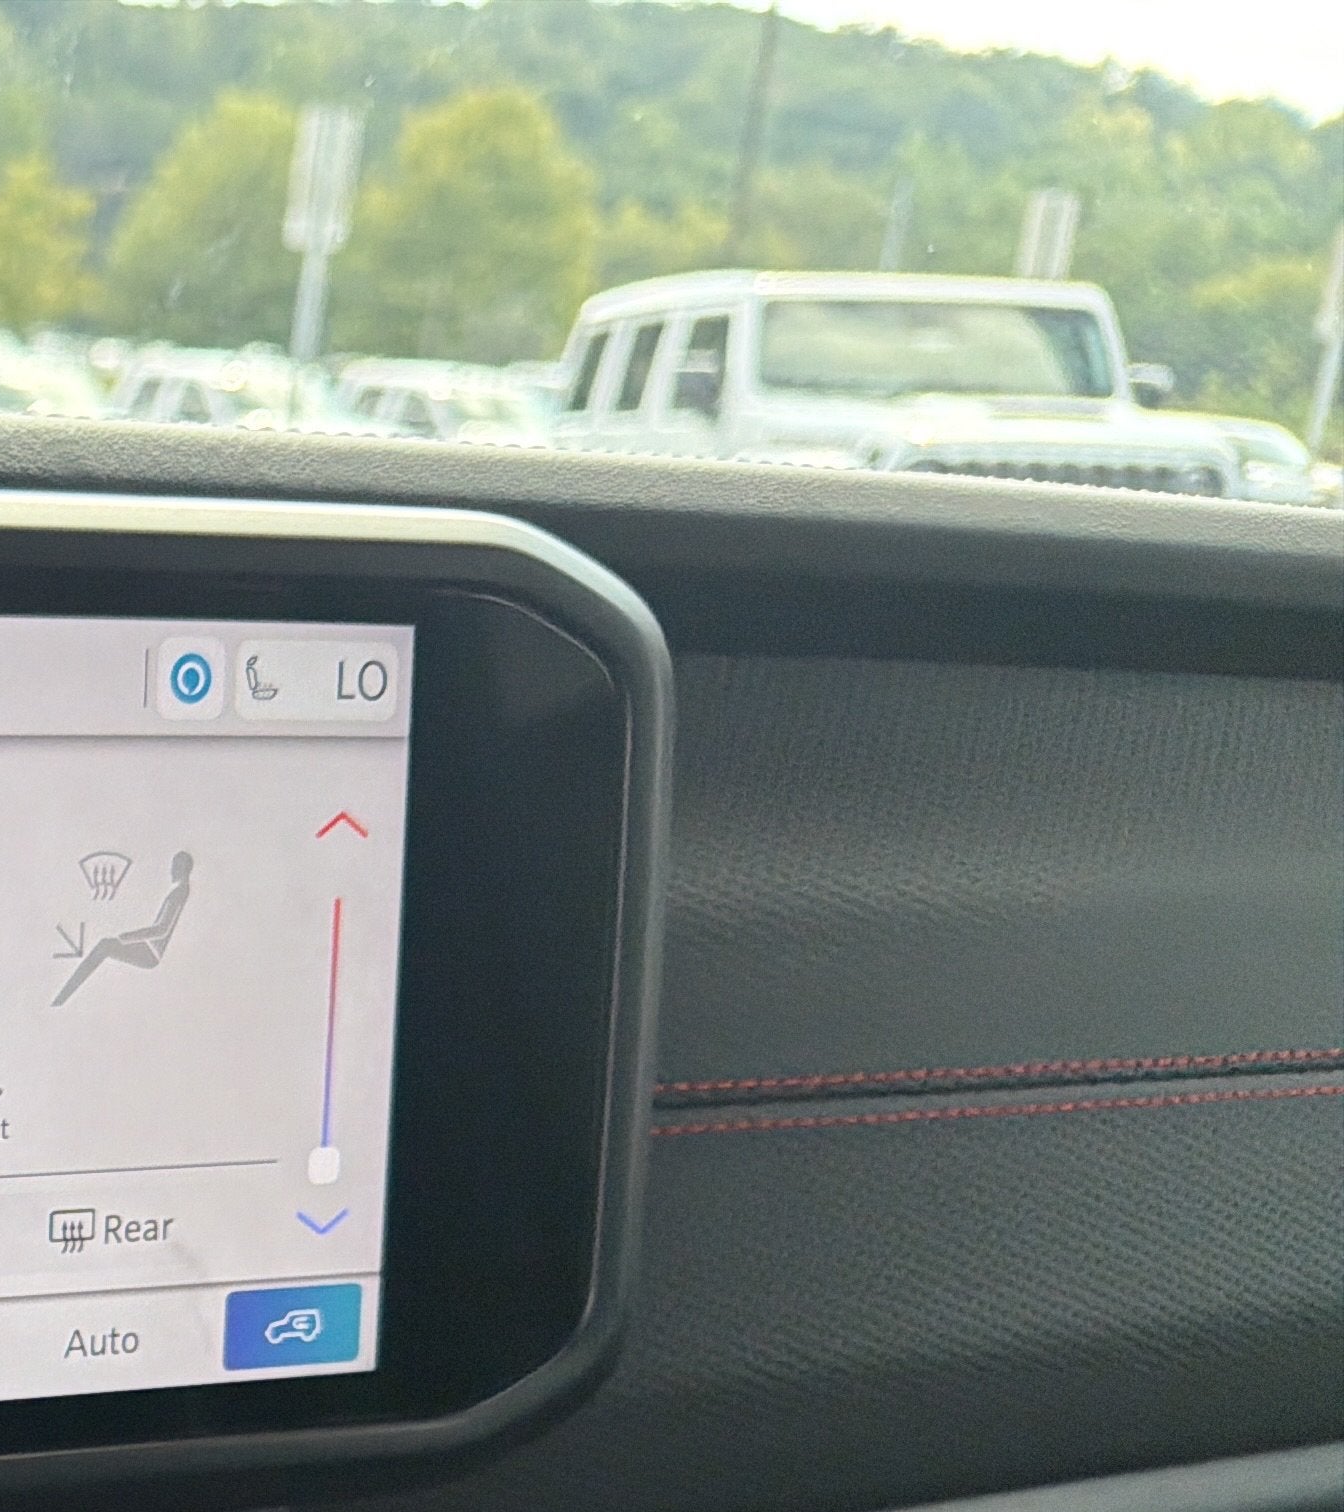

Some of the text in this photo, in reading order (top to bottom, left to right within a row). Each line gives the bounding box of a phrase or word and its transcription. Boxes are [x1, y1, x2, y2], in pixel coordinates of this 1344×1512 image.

[337, 660, 387, 700] LO
[102, 1212, 174, 1245] Rear
[64, 1324, 140, 1358] Auto
